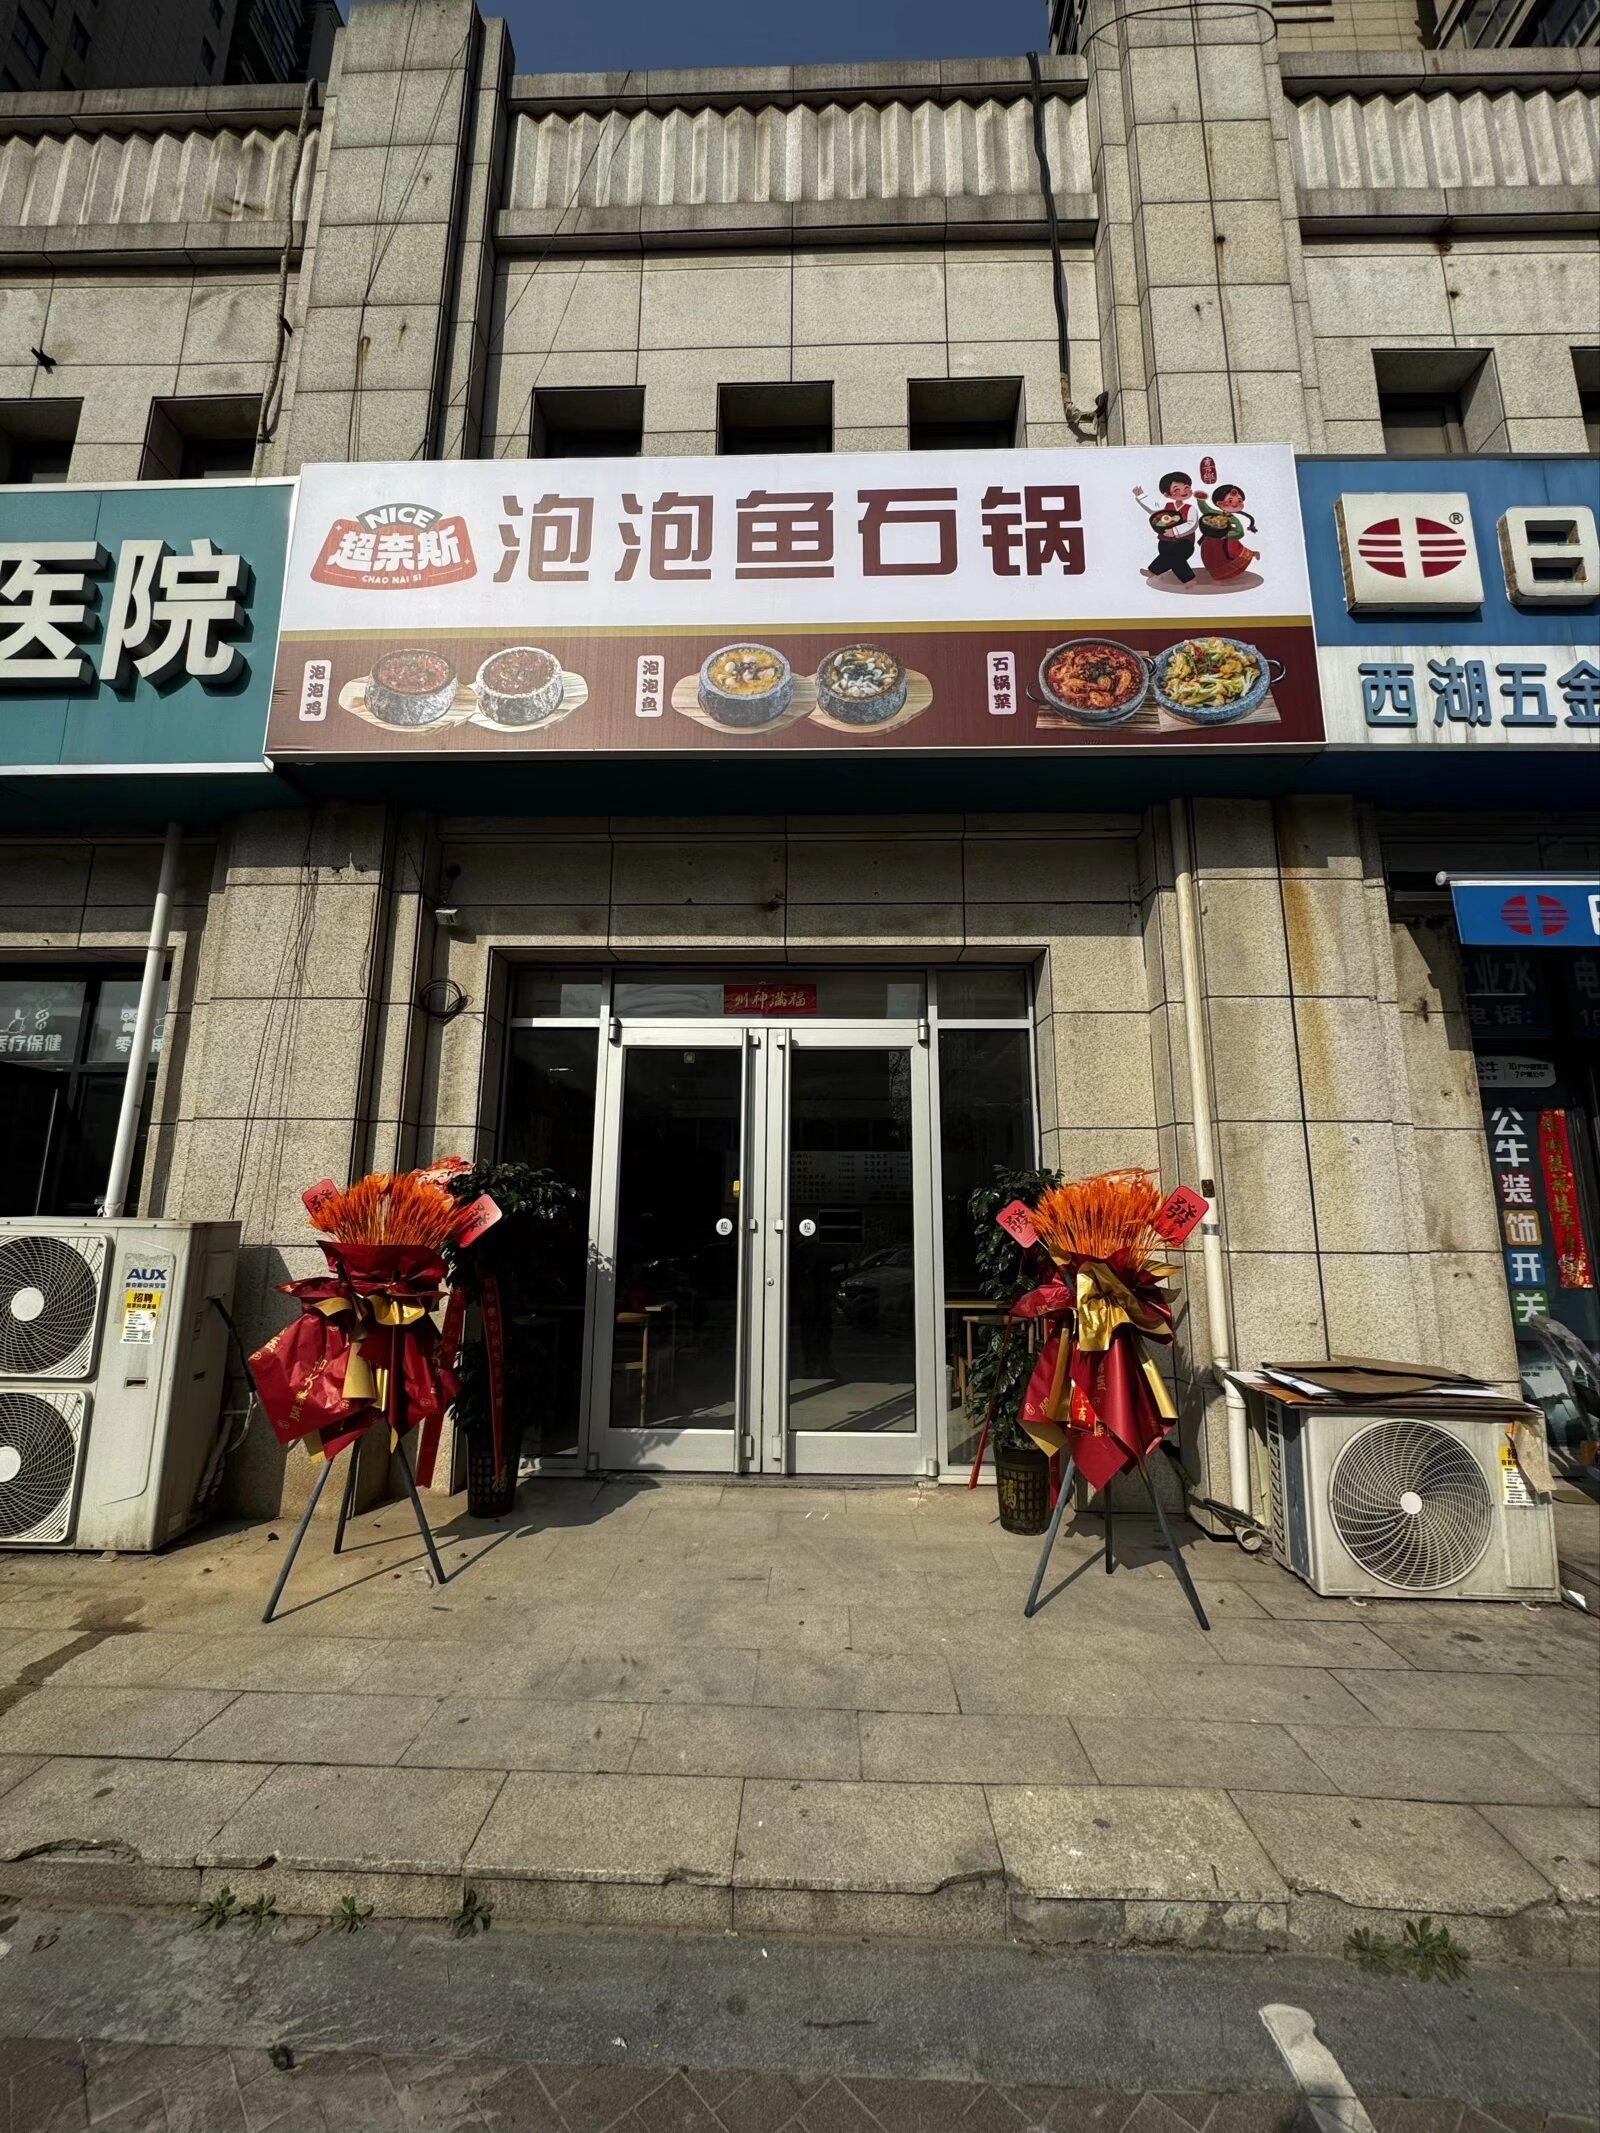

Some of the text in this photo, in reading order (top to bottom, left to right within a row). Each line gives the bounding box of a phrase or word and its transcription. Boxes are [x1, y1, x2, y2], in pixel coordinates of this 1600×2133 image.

[364, 506, 435, 529] NICE
[493, 485, 1085, 582] 泡泡鱼石锅
[326, 525, 462, 572] 超奈斯
[1500, 505, 1600, 600] 日
[362, 574, 388, 584] CHAO
[392, 576, 410, 584] NAI
[0, 538, 246, 682] 医院
[304, 664, 327, 718] 泡泡鸡
[641, 658, 662, 713] 泡泡鱼
[992, 655, 1013, 711] 石锅菜
[1358, 657, 1600, 728] 西湖五金
[127, 1268, 168, 1281] AUX
[133, 1292, 154, 1303] 招聘
